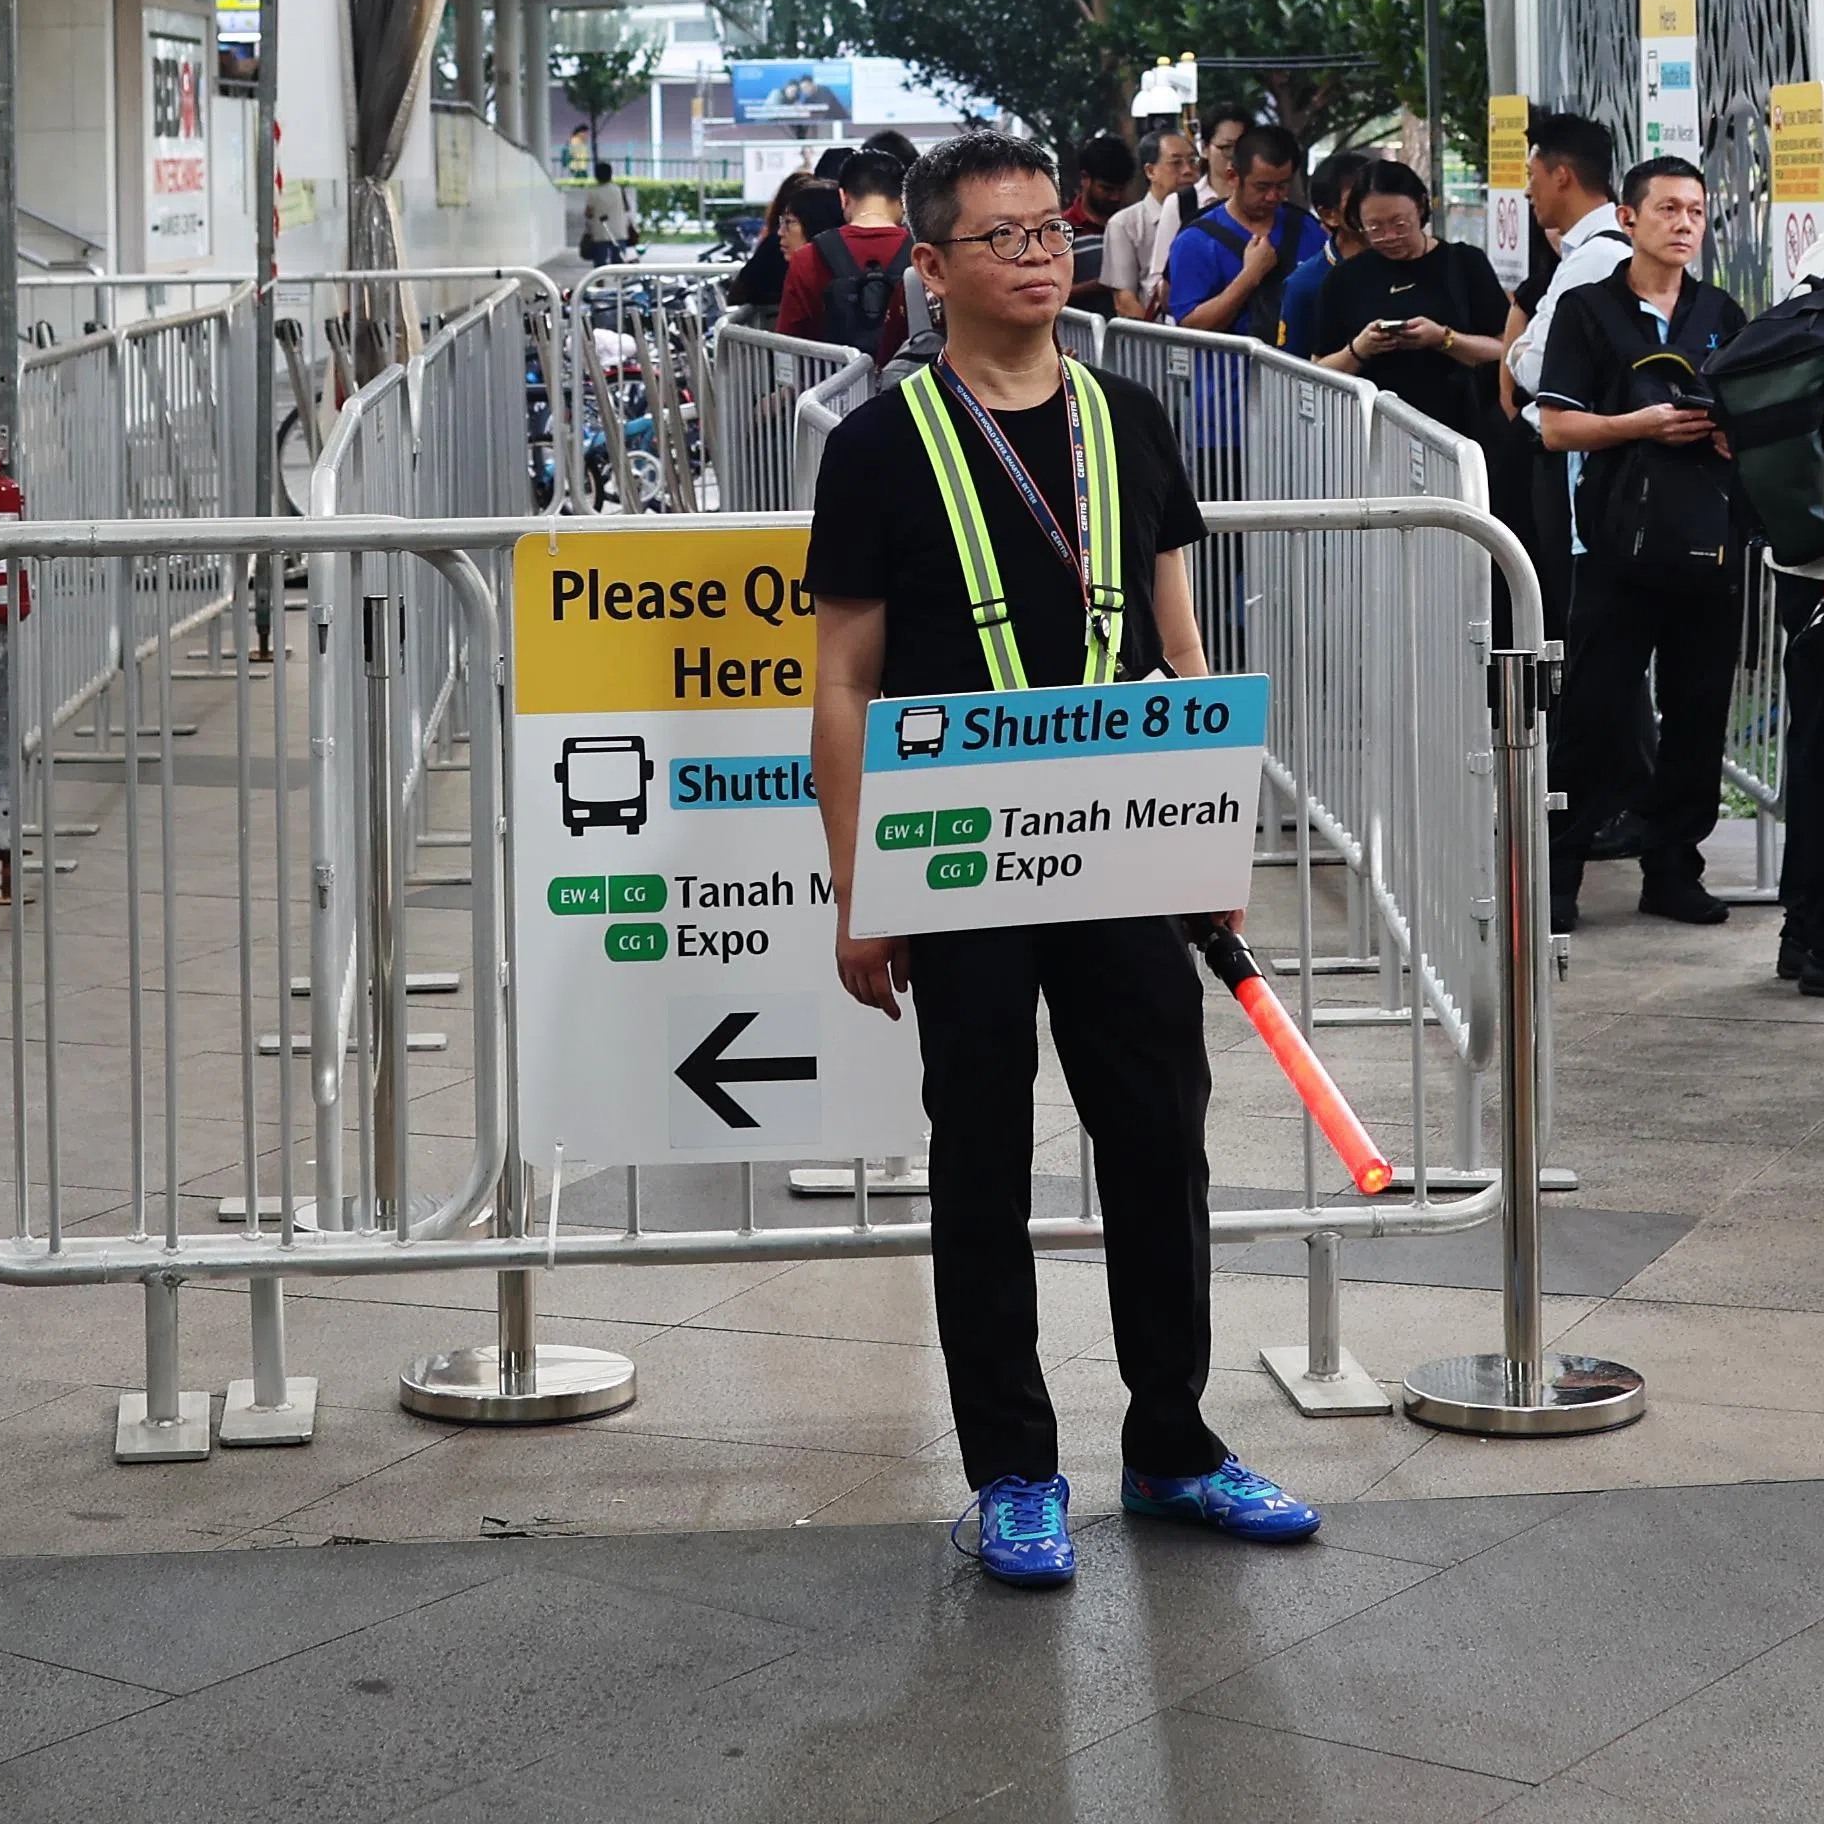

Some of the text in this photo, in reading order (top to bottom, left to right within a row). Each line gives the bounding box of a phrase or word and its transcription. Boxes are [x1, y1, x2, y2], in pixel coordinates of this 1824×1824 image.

[1050, 530, 1070, 559] CERTIS
[552, 568, 727, 621] Please
[674, 646, 803, 699] Here
[961, 696, 1230, 751] Shuttle 8 to
[884, 792, 1239, 841] EW 4 CG Tanah Merah
[560, 871, 794, 909] EW 4 CG Tanah
[939, 851, 1083, 886] CG 1 Expo
[618, 924, 769, 964] CG 1 Expo
